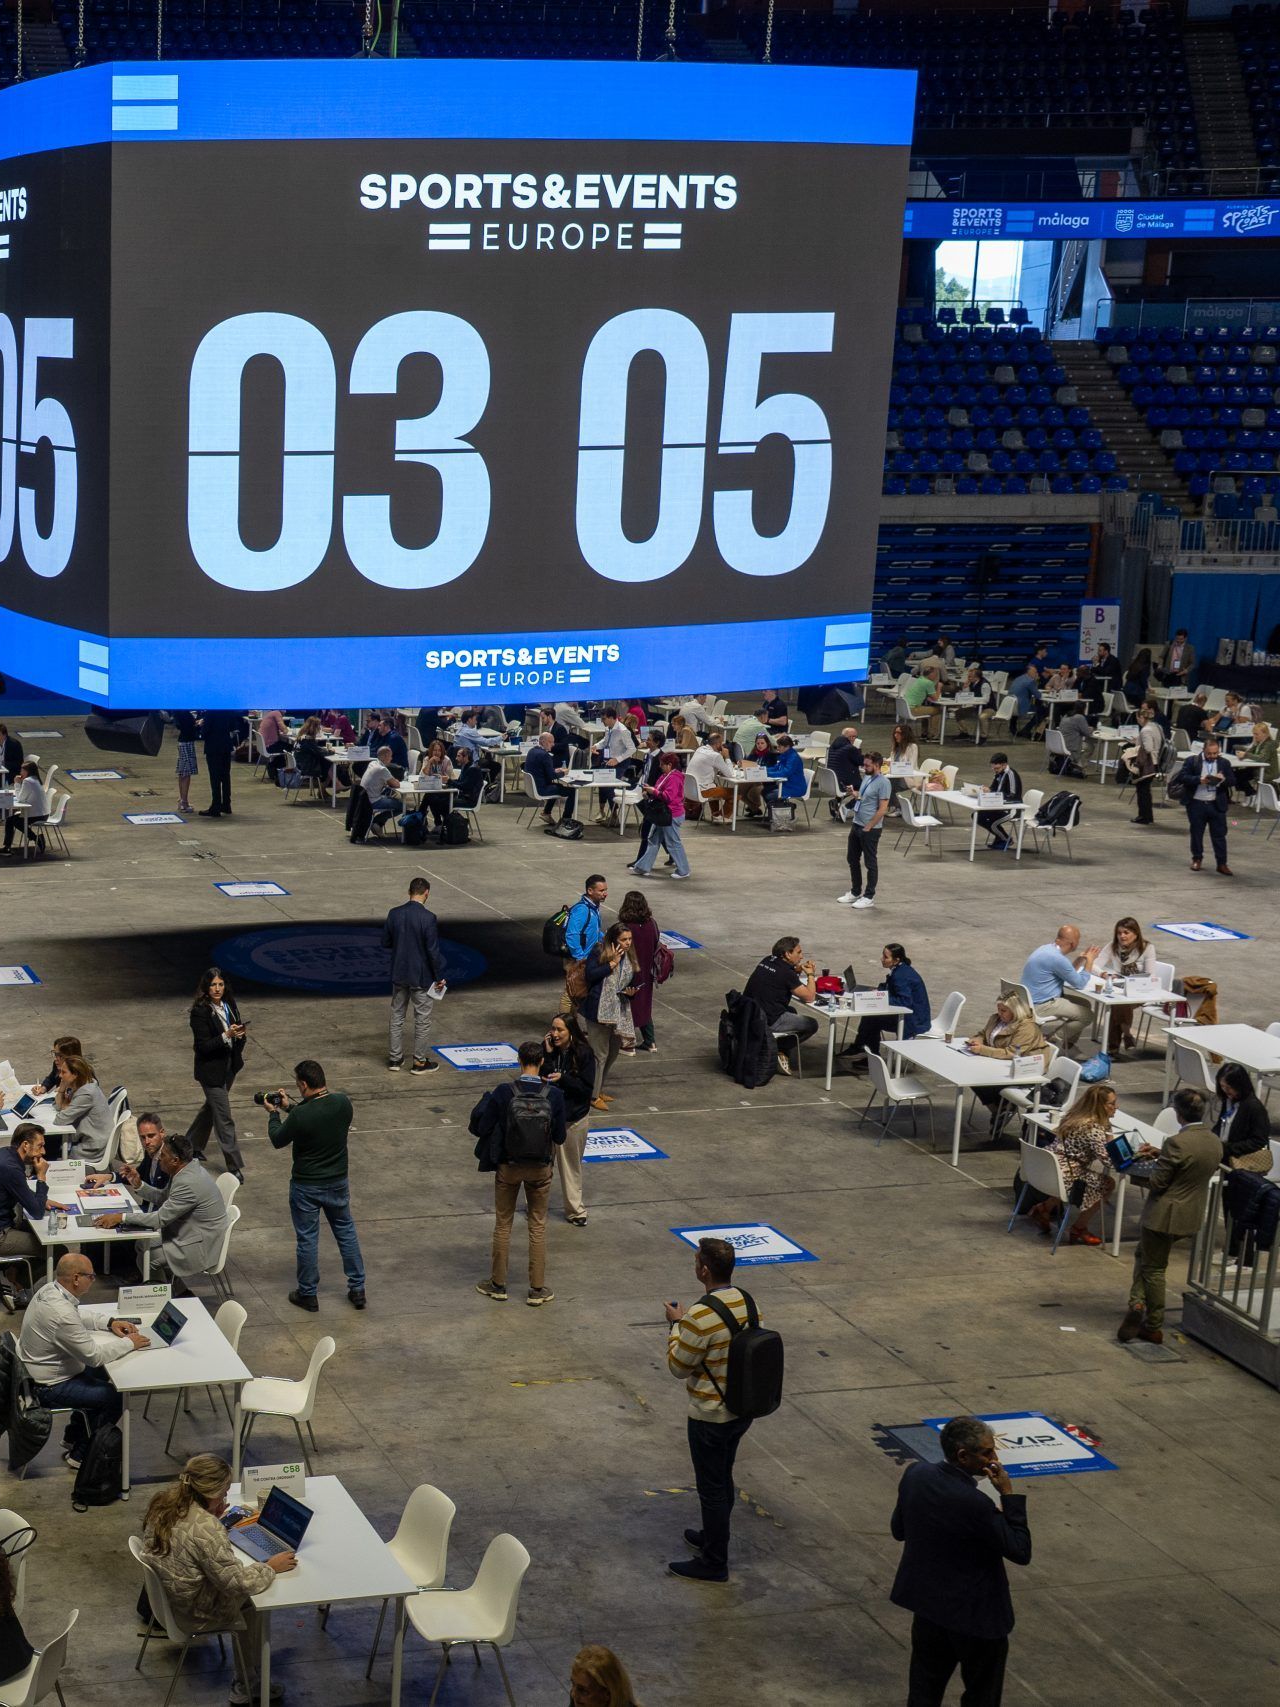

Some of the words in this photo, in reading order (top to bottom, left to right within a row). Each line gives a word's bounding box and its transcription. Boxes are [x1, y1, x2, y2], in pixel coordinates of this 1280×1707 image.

[359, 172, 738, 210] SPORTS&EVENTS
[952, 208, 1003, 218] SPORTS
[1137, 213, 1164, 221] Ciudad
[1222, 205, 1270, 228] SPORTS
[952, 217, 1002, 227] &EVENTS
[1147, 220, 1174, 229] Málaga
[482, 222, 632, 250] EUROPE
[187, 310, 492, 592] 03
[575, 307, 836, 583] 05
[1095, 607, 1105, 624] B
[1084, 629, 1092, 637] A
[1085, 646, 1091, 654] D
[425, 644, 620, 669] SPORTS&EVENTS
[486, 671, 565, 686] EUROPE
[1002, 1435, 1056, 1446] VIP
[283, 1465, 300, 1473] C58
